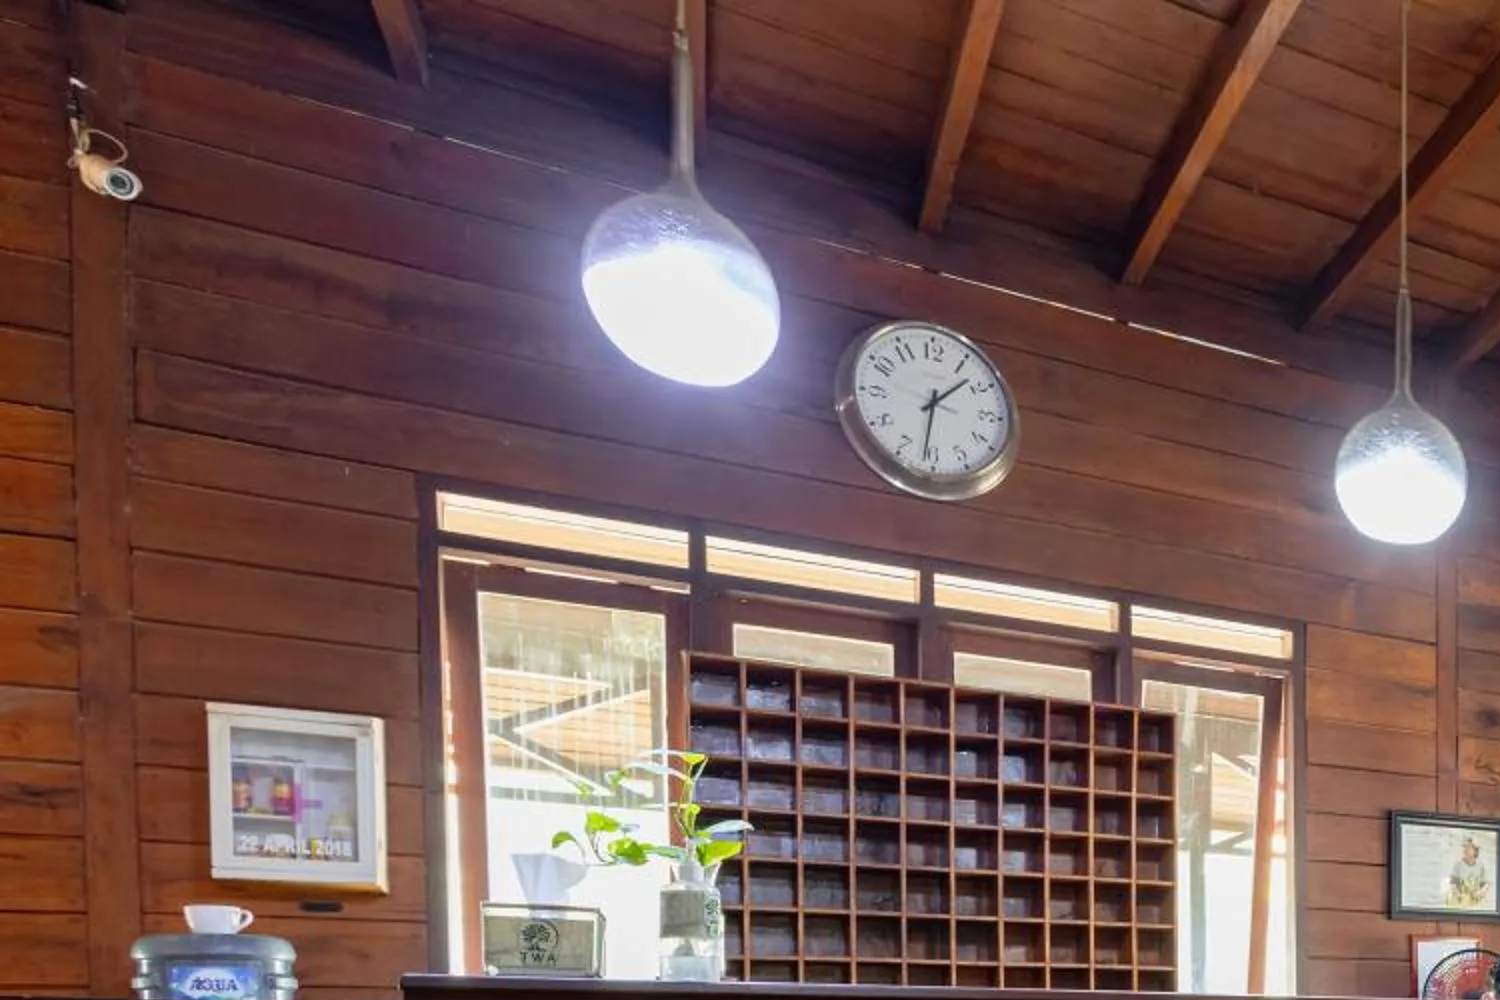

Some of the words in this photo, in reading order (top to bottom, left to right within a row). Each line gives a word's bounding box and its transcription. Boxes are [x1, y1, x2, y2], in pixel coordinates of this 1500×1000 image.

[895, 342, 915, 364] 11
[924, 341, 944, 363] 12
[873, 355, 896, 377] 10
[954, 359, 966, 375] 1
[868, 384, 887, 399] 9
[978, 409, 995, 424] 3
[897, 434, 913, 450] 7
[970, 431, 988, 446] 4
[952, 444, 967, 462] 5
[520, 951, 557, 968] TWA
[189, 976, 239, 993] AQUA
